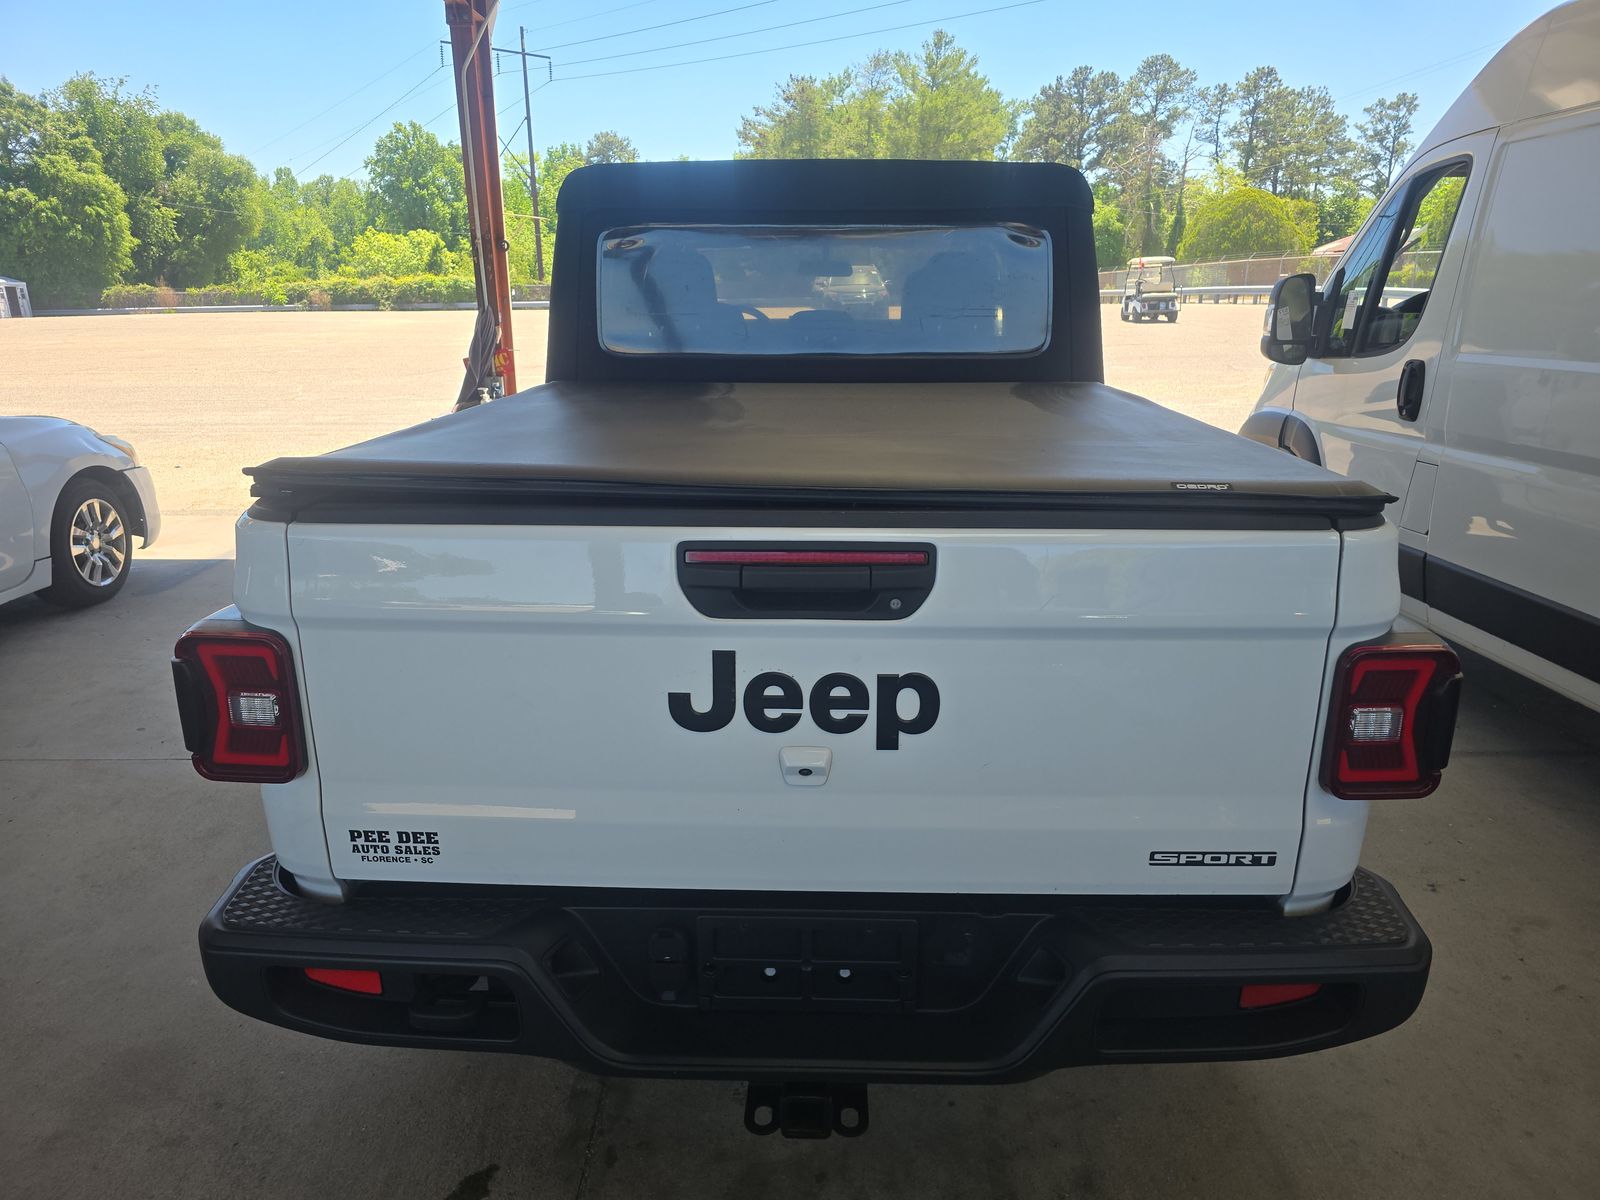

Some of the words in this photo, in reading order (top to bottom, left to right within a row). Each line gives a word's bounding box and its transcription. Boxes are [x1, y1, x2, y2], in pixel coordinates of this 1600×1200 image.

[668, 650, 940, 750] Jeep
[349, 830, 390, 843] PEE
[397, 831, 439, 844] DEE
[352, 844, 389, 854] AUTO
[395, 846, 440, 855] SALES
[361, 855, 411, 863] FLORENCE
[1149, 851, 1277, 866] SPORT
